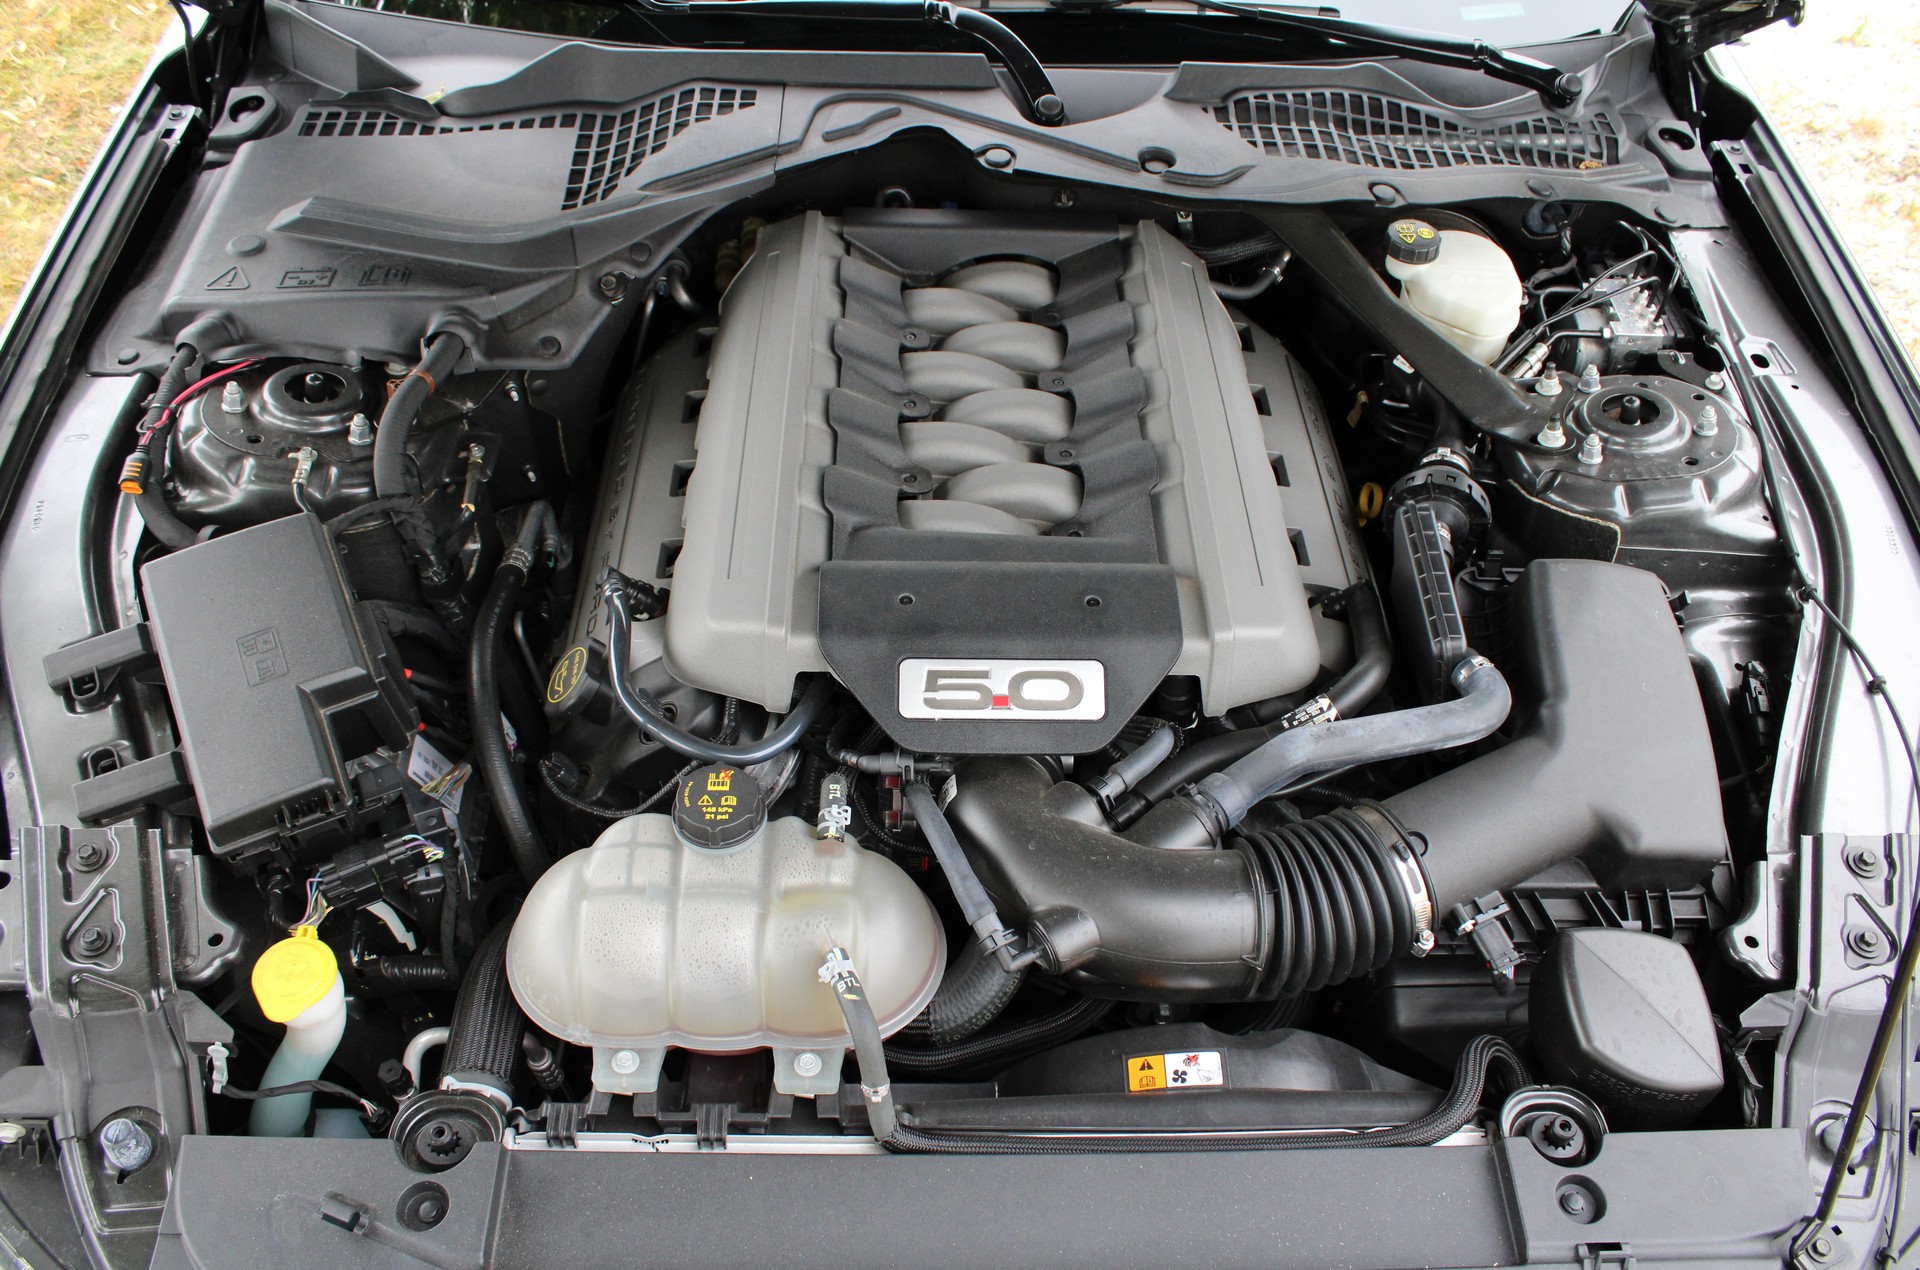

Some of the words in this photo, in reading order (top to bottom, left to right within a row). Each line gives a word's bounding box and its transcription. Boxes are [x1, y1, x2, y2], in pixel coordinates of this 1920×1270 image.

[605, 507, 620, 540] BY
[586, 551, 610, 636] FRD
[922, 668, 1084, 711] 5.0
[837, 977, 859, 992] BTL
